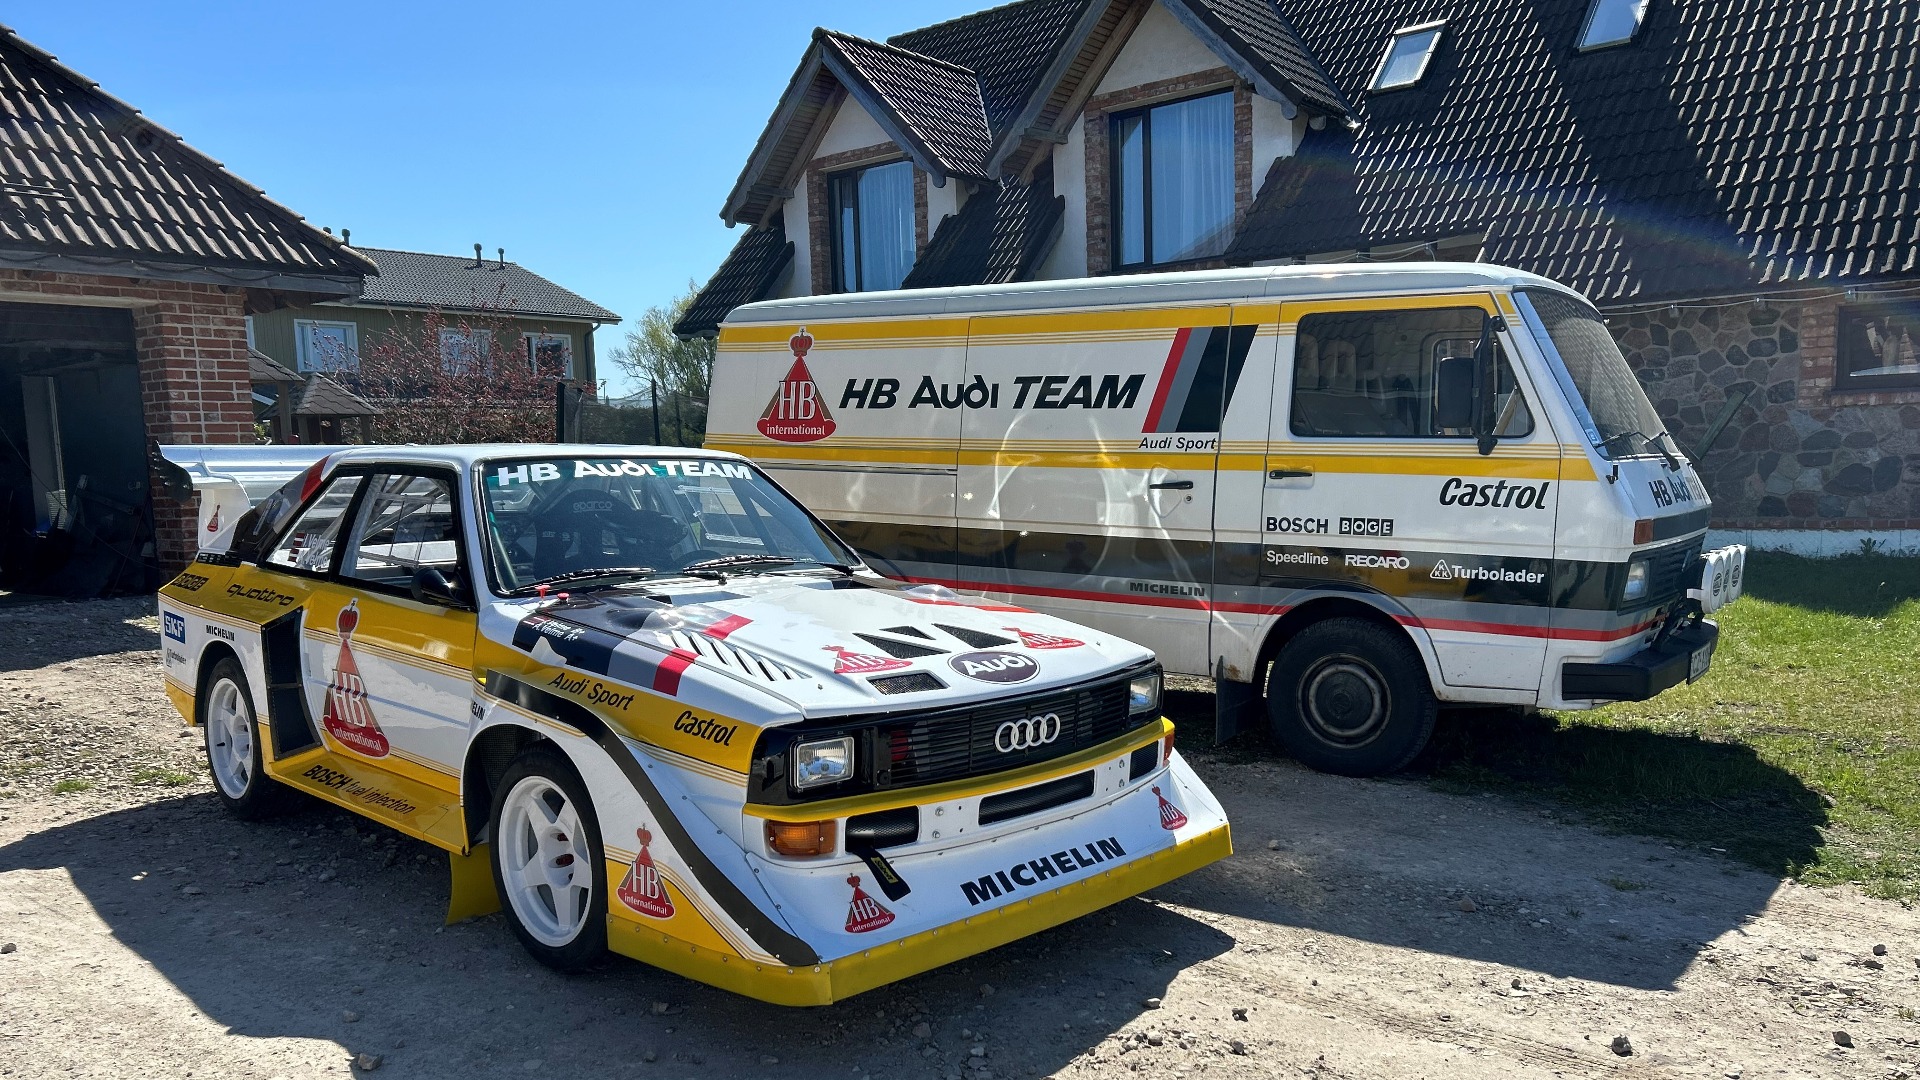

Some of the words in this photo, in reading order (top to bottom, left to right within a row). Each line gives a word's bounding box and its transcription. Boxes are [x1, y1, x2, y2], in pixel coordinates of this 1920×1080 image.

[778, 380, 816, 420] HB
[839, 378, 900, 410] HB
[908, 375, 999, 410] Audi
[1012, 374, 1147, 410] TEAM
[766, 423, 826, 438] international
[1139, 437, 1172, 450] Audi
[1176, 437, 1217, 452] Sport
[498, 463, 561, 486] HB
[574, 460, 656, 478] Audi
[657, 461, 752, 480] TEAM
[1439, 478, 1550, 509] Castrol
[1648, 480, 1673, 508] HB
[1266, 517, 1329, 534] BOSCH
[1339, 517, 1394, 536] BOGE
[1266, 551, 1329, 565] Speedline
[1345, 554, 1410, 570] RECARO
[1452, 565, 1545, 583] Turbolader
[227, 584, 294, 606] quattro
[1130, 583, 1205, 597] MICHELIN
[164, 614, 185, 638] SKF
[206, 625, 235, 641] MICHELIN
[965, 654, 1035, 677] Audi
[332, 668, 368, 728] HB
[547, 672, 586, 696] Audi
[587, 683, 634, 711] Sport
[331, 724, 383, 751] international
[673, 710, 738, 746] Castrol
[302, 764, 352, 790] BOSCH
[342, 781, 369, 797] fuel
[363, 785, 416, 815] injection
[631, 861, 659, 899] HB
[960, 836, 1127, 906] MICHELIN
[624, 892, 668, 916] international
[850, 897, 880, 922] HB
[851, 916, 891, 932] international
